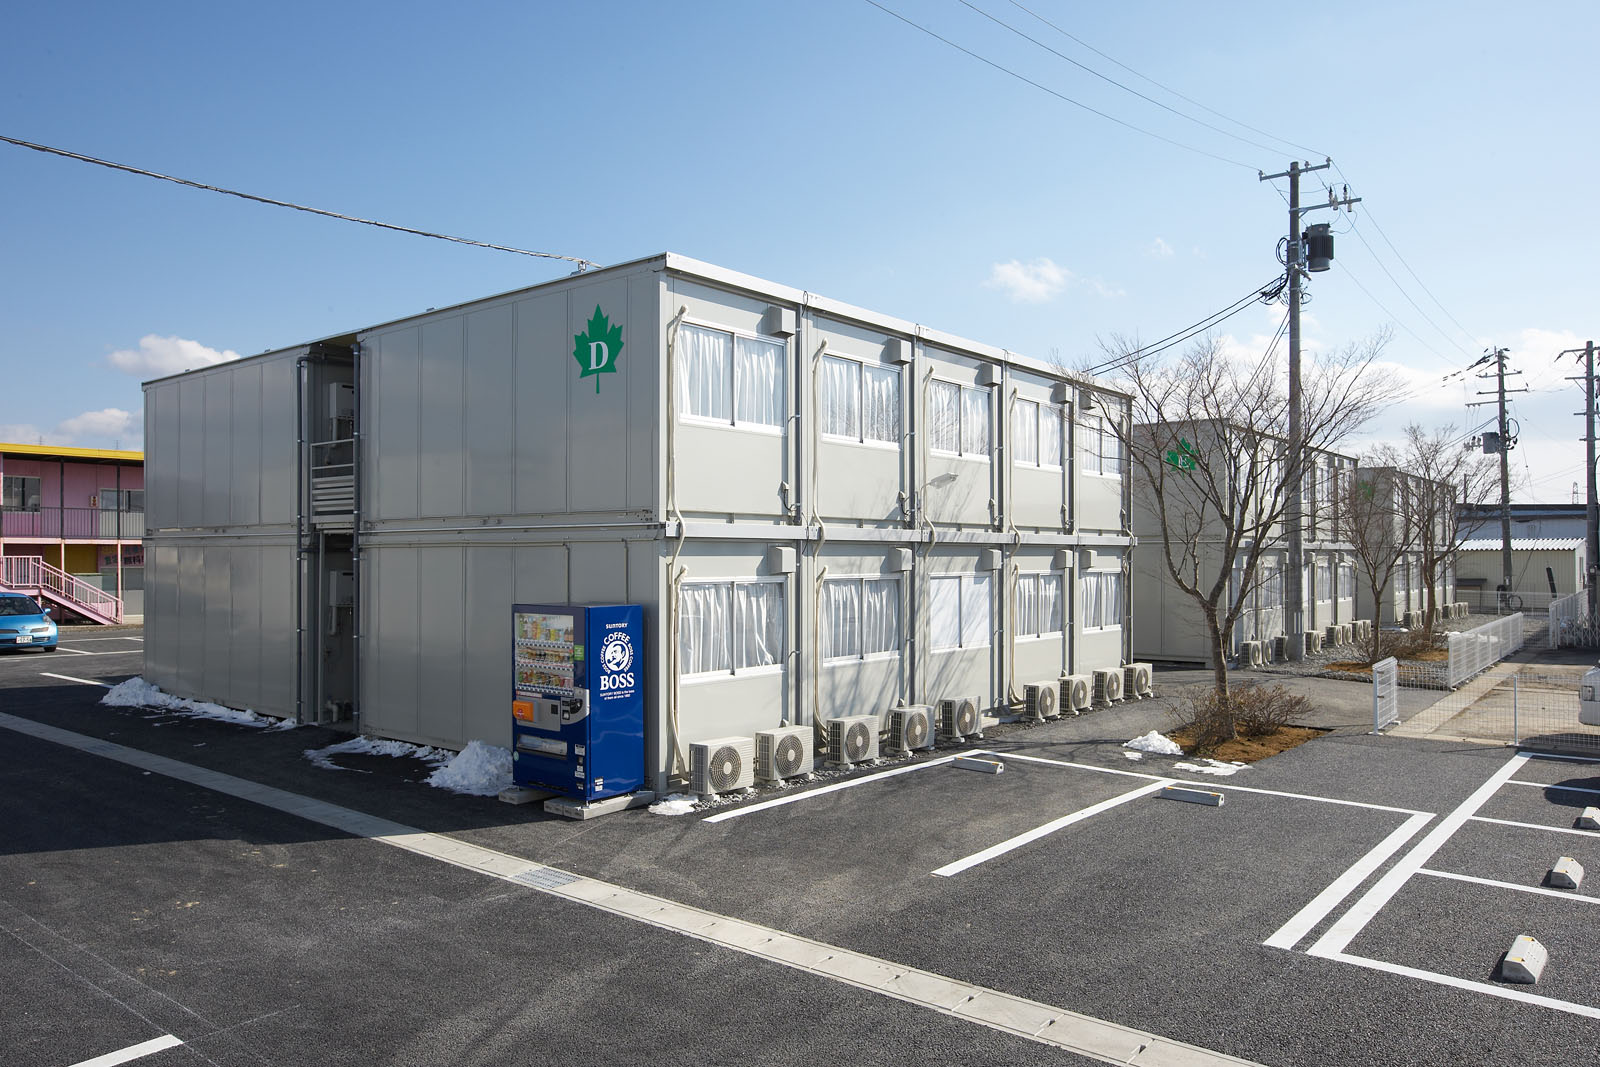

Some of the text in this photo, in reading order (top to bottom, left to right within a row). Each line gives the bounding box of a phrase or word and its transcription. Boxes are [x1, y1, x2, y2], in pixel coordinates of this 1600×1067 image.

[588, 341, 609, 370] D
[604, 632, 630, 645] COFFEE
[600, 672, 634, 690] BOSS
